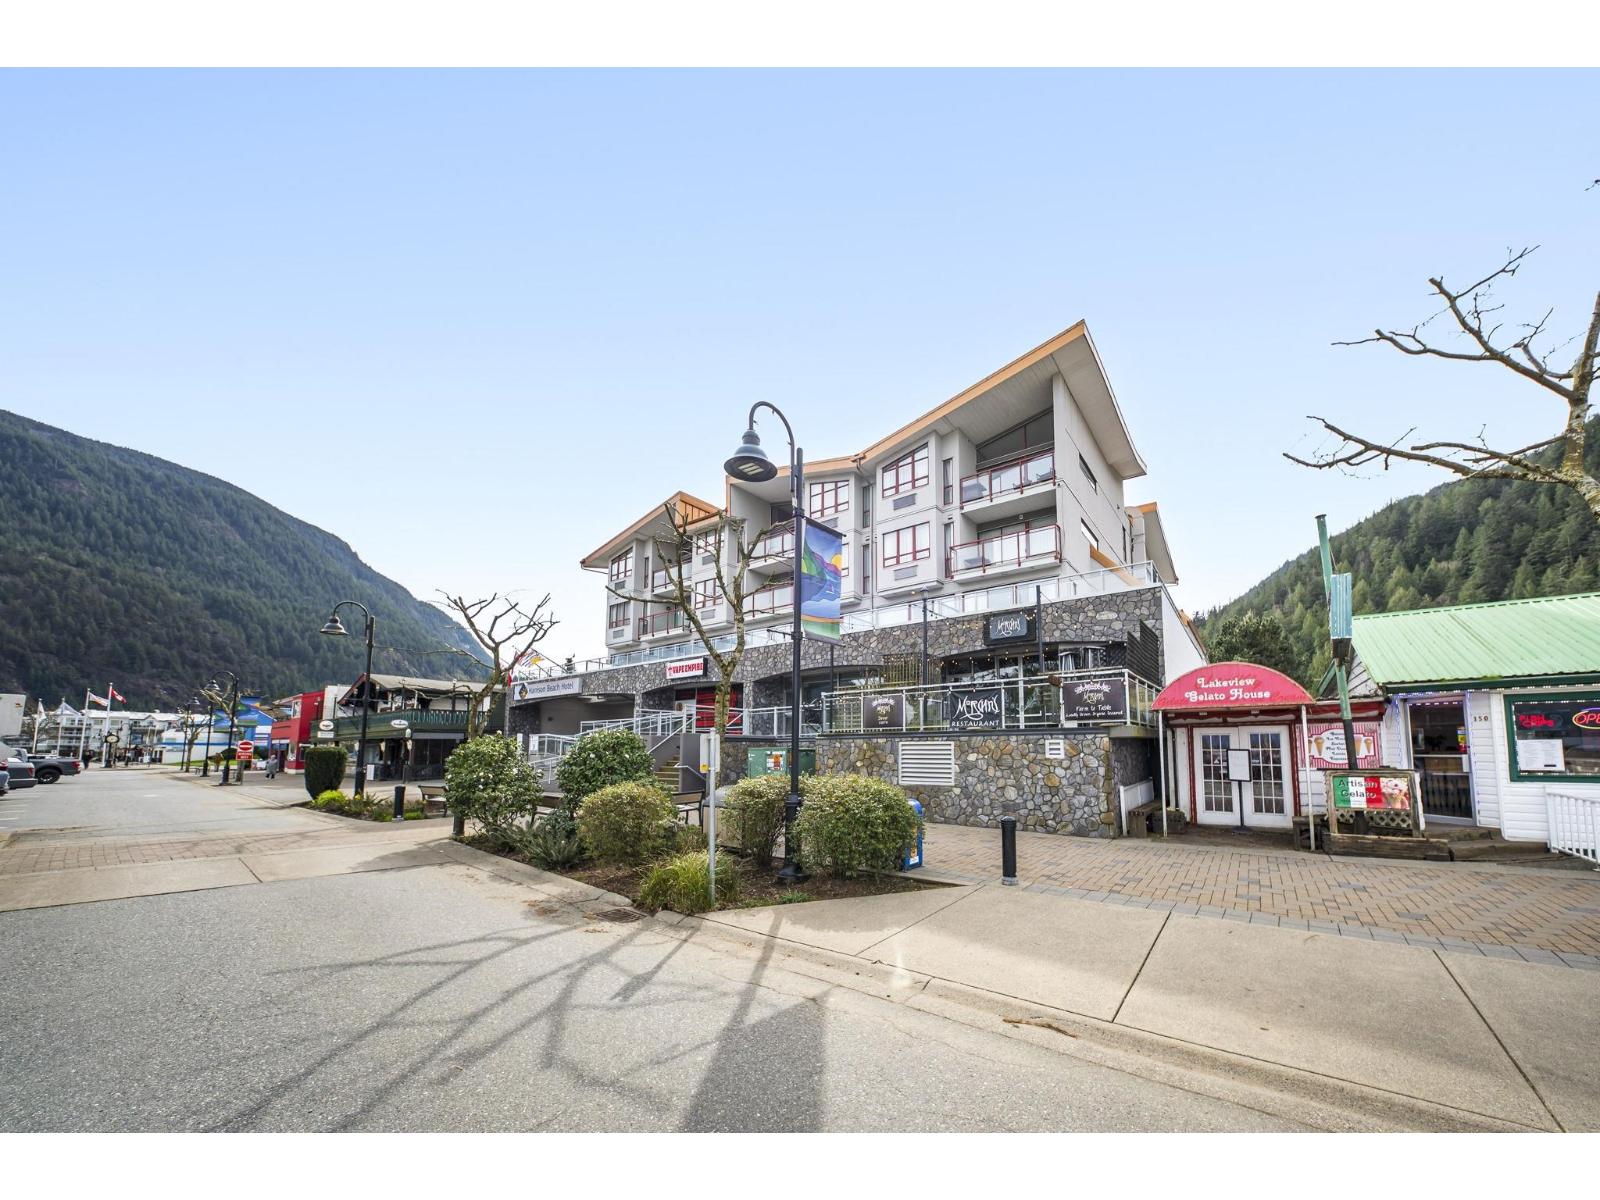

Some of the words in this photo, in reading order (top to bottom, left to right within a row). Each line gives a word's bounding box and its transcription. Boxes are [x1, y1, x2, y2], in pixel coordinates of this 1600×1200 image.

[547, 683, 560, 692] Beach
[1197, 677, 1256, 689] Lakeview
[1184, 690, 1226, 702] Gelato
[1229, 688, 1271, 701] House
[1338, 779, 1378, 790] Artisan
[1341, 790, 1377, 799] Gelato
